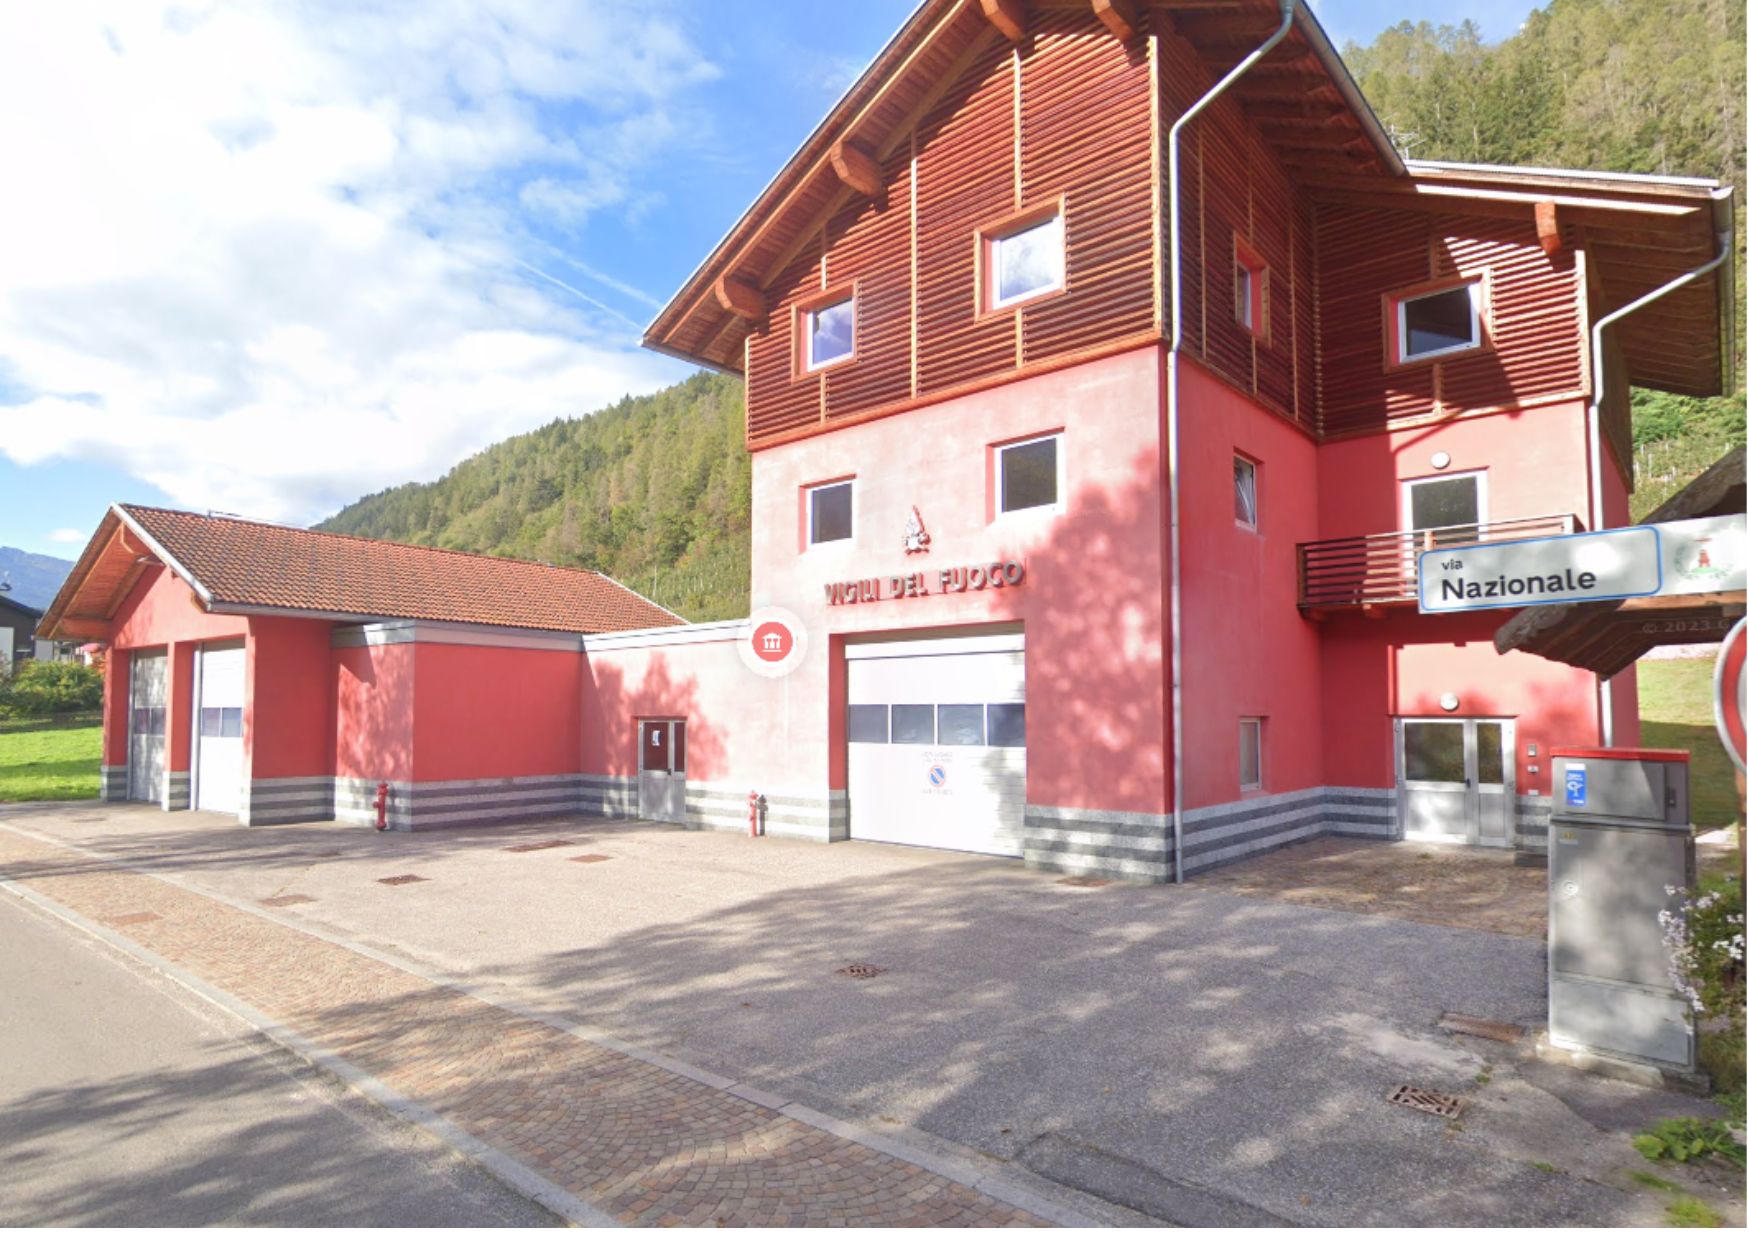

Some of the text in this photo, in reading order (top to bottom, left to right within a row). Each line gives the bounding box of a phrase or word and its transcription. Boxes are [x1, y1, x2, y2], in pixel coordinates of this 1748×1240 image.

[1441, 559, 1464, 571] via
[824, 559, 1025, 605] VIGILI DEL FUOCO
[1441, 568, 1597, 601] Nazionale
